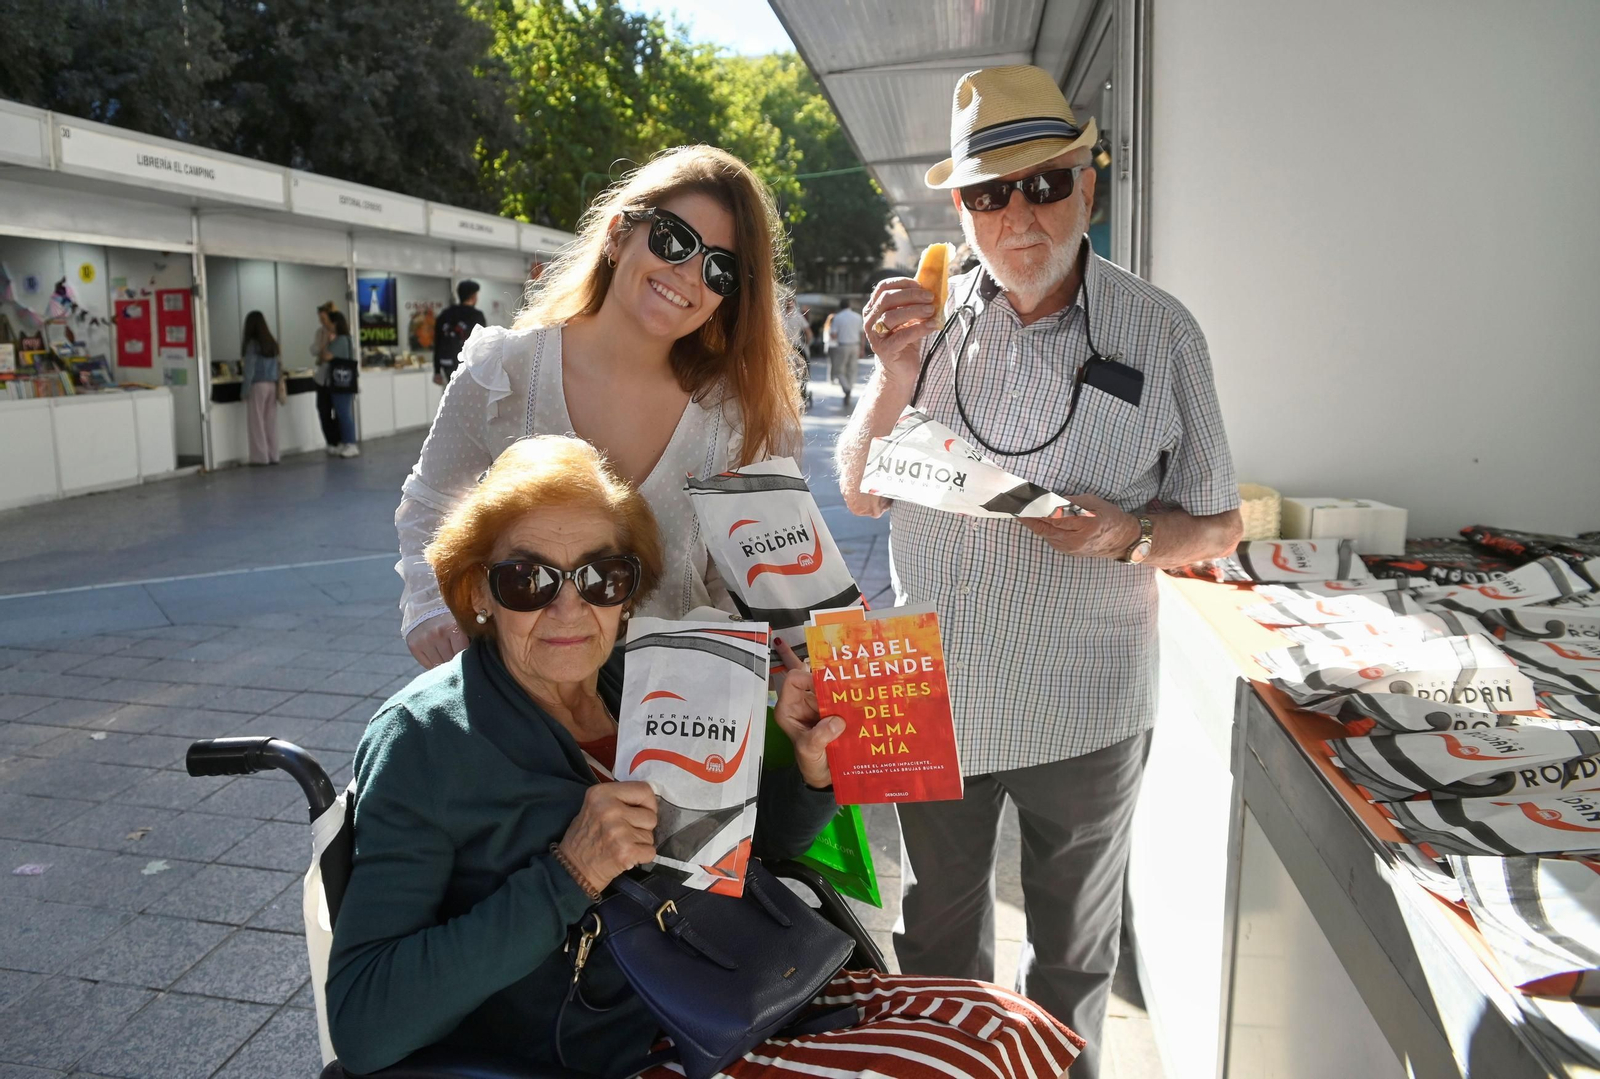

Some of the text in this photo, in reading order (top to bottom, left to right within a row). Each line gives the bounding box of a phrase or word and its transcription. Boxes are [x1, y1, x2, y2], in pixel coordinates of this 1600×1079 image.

[136, 153, 215, 180] LIBRERÍA EL CAMPING
[360, 327, 396, 341] OVNIS
[877, 455, 967, 488] ROLDAN
[739, 523, 805, 545] HERMANOS
[741, 528, 810, 558] ROLDAN
[831, 638, 918, 662] ISABEL
[823, 656, 934, 682] ALLENDE
[832, 682, 931, 704] MUJERES
[647, 713, 737, 725] HERMANOS
[864, 704, 905, 719] DEL
[646, 720, 736, 743] ROLDAN
[859, 722, 917, 738] ALMA
[870, 737, 910, 756] MÍA
[1519, 756, 1600, 788] ROLD
